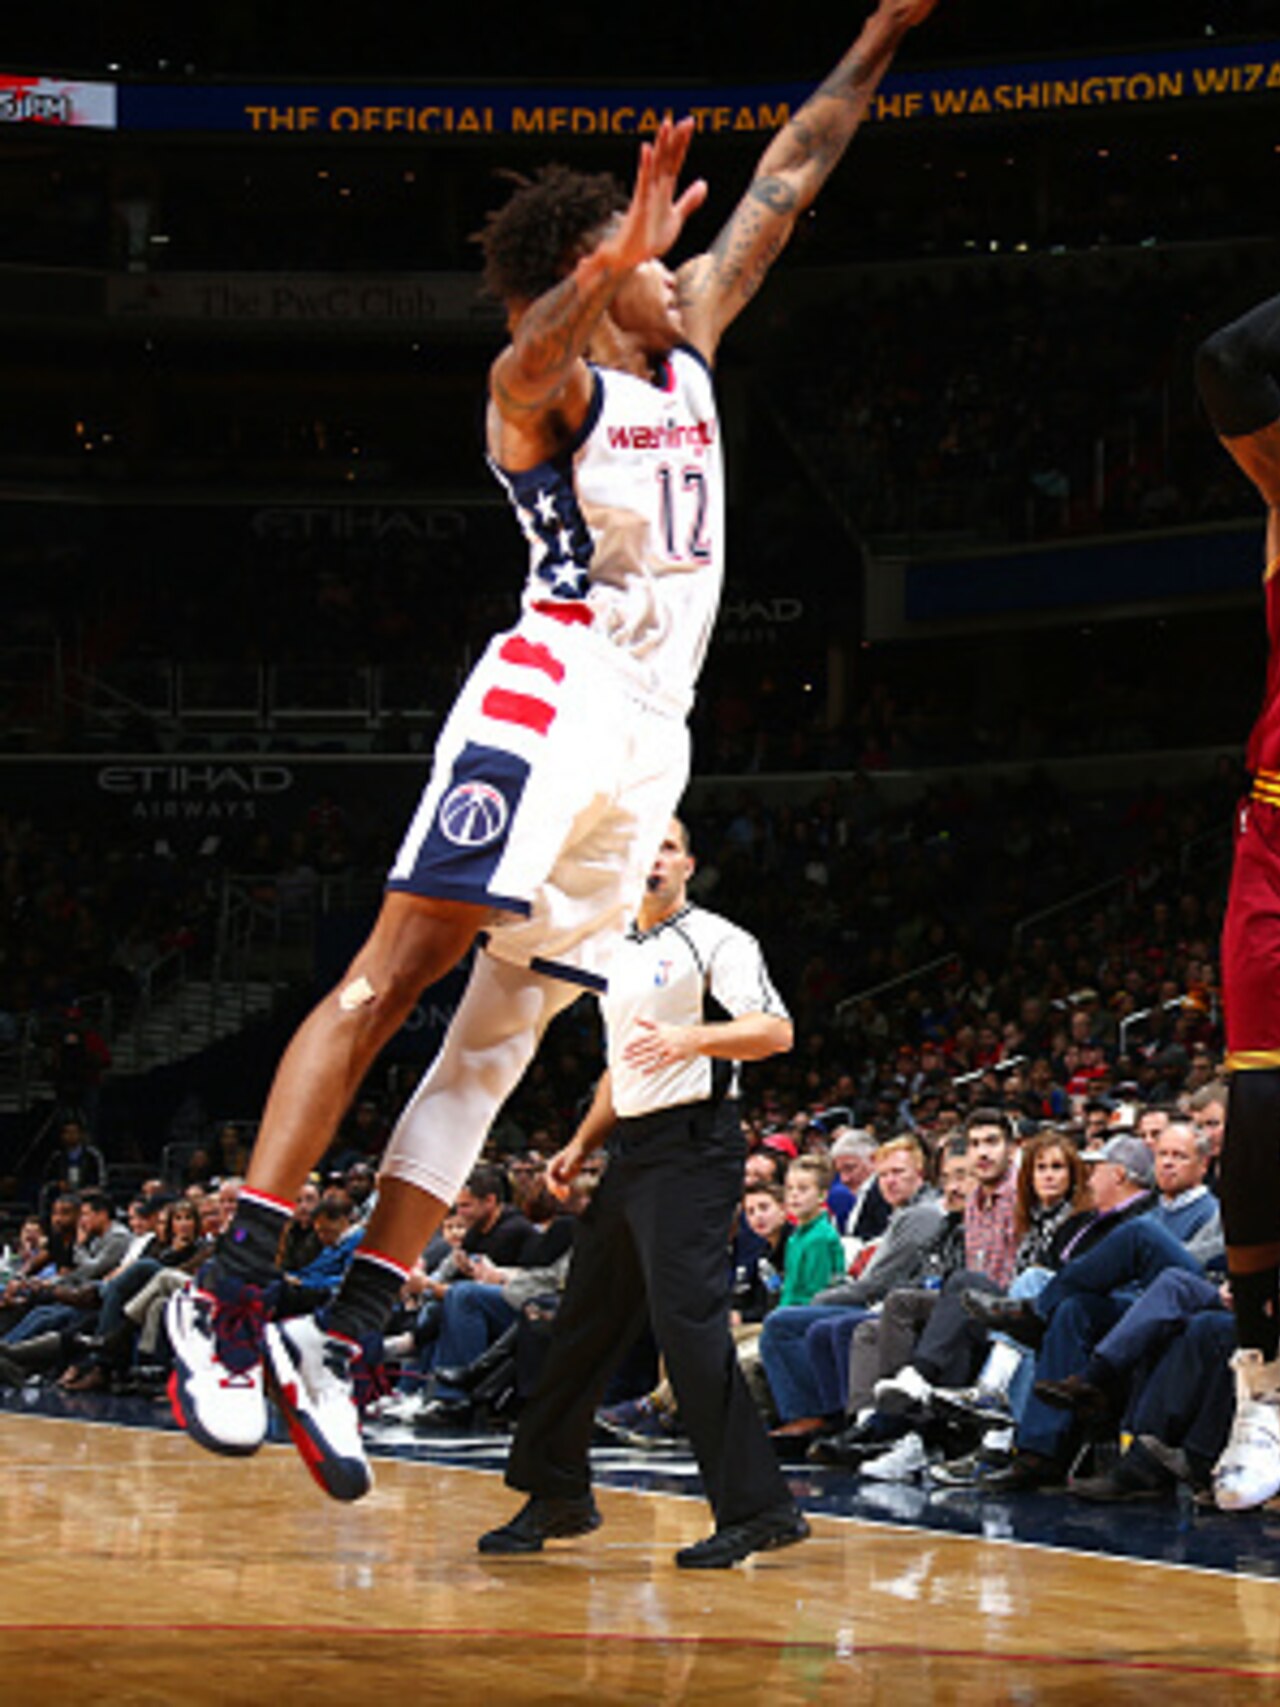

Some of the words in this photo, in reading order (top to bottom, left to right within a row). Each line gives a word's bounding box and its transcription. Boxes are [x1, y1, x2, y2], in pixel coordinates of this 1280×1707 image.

[245, 105, 320, 131] THE
[330, 105, 493, 132] OFFICIAL
[690, 103, 790, 131] TEAM
[861, 92, 922, 120] HE
[931, 71, 1183, 114] WASHINGTON
[201, 284, 260, 316] The
[272, 284, 351, 316] PwC
[360, 283, 437, 316] Club
[252, 508, 468, 541] ETIHAD
[654, 463, 711, 565] 12
[721, 597, 804, 623] HAD
[97, 765, 293, 793] ETIHAD
[132, 799, 256, 820] AIRWAYS
